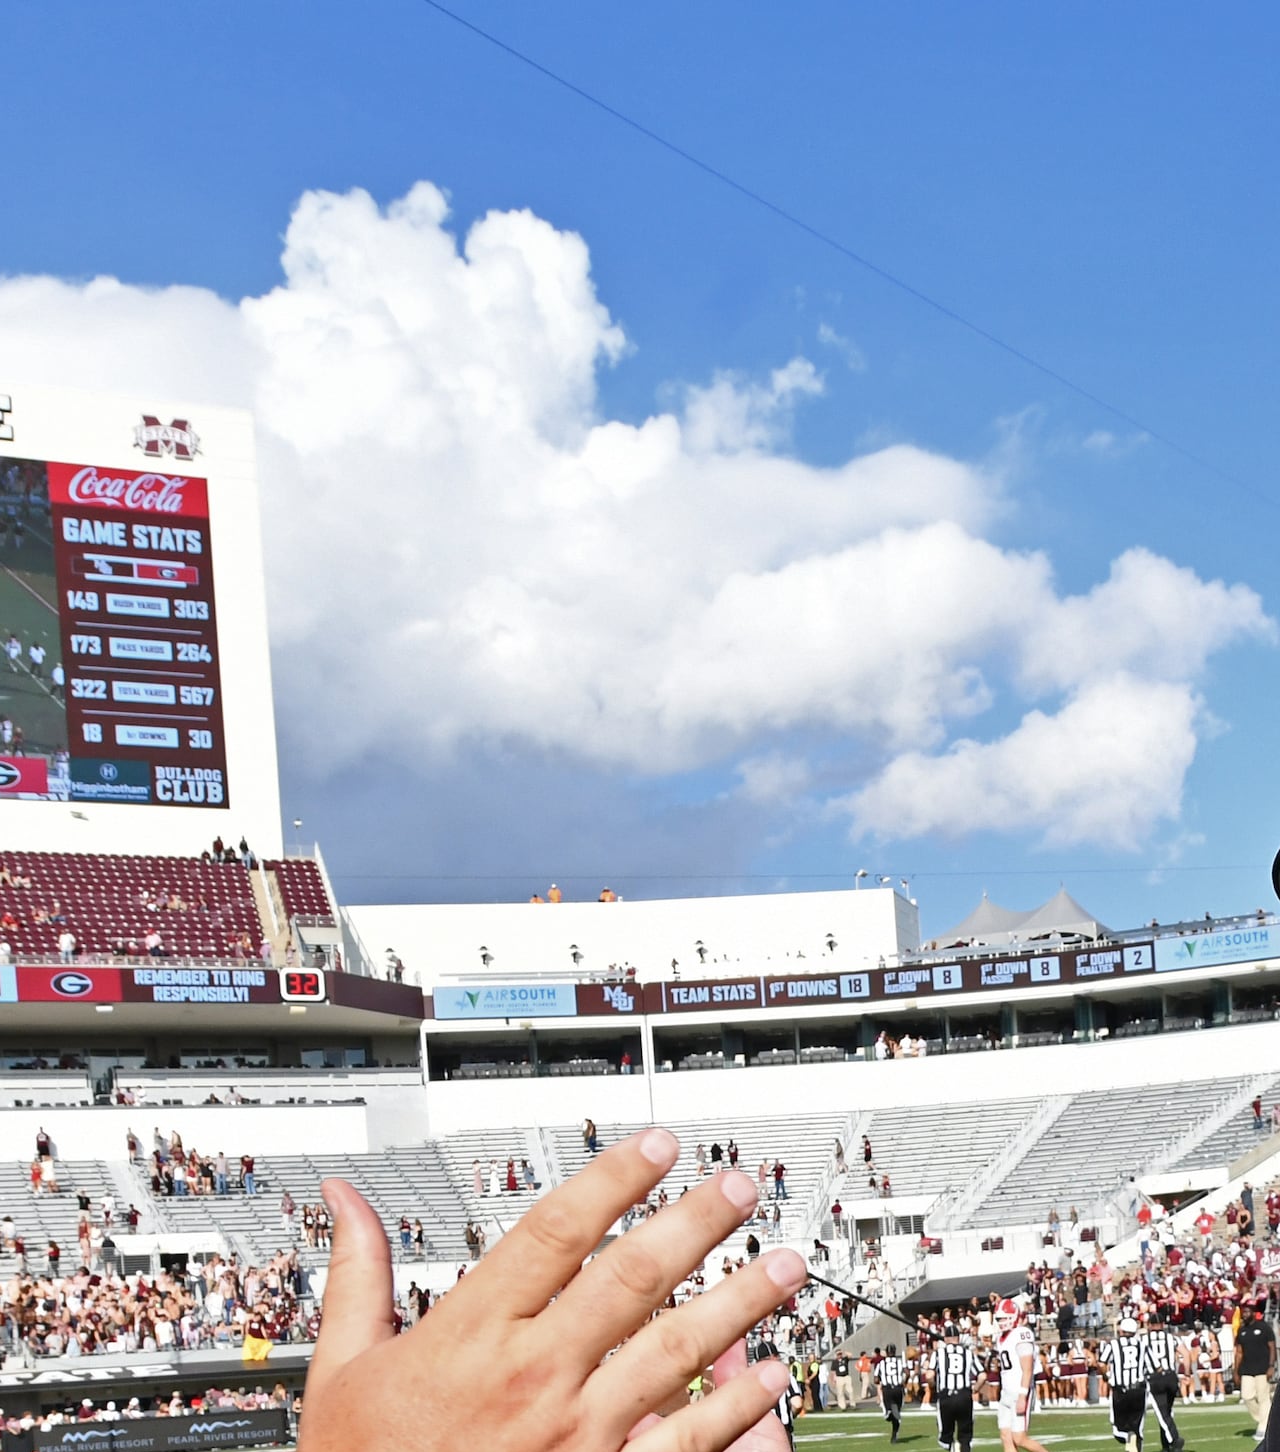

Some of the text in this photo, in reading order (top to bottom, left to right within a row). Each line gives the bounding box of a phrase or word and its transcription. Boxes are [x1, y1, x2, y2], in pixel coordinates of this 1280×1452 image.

[68, 467, 188, 513] Coca-Cola
[62, 517, 202, 554] GAME STATS
[67, 590, 99, 611] 149
[173, 599, 209, 620] 303
[70, 634, 101, 655] 173
[176, 642, 212, 663] 264
[71, 678, 107, 699] 322
[180, 685, 214, 706] 567
[82, 723, 102, 743] 18
[188, 729, 213, 749] 30
[155, 765, 222, 782] BULLDOG
[156, 779, 223, 803] CLUB
[1201, 931, 1268, 949] AIRSOUTH
[1090, 950, 1121, 965] DOWN
[1134, 951, 1142, 966] 2
[133, 969, 266, 986] REMEMBER TO RING
[898, 969, 930, 984] DOWN
[943, 970, 952, 985] 8
[995, 961, 1028, 975] DOWN
[1041, 961, 1050, 976] 8
[289, 973, 318, 995] 32
[770, 979, 837, 998] 1ST DOWNS
[848, 978, 863, 993] 18
[153, 986, 249, 1002] RESPONSIBLY!
[484, 988, 556, 1001] AIRSOUTH
[671, 984, 756, 1005] TEAM STATS
[948, 1352, 964, 1375] B
[1121, 1345, 1139, 1370] R
[77, 1441, 109, 1451] RIVER
[112, 1438, 154, 1449] RESORT
[168, 1429, 277, 1445] PEARL RIVER RESORT
